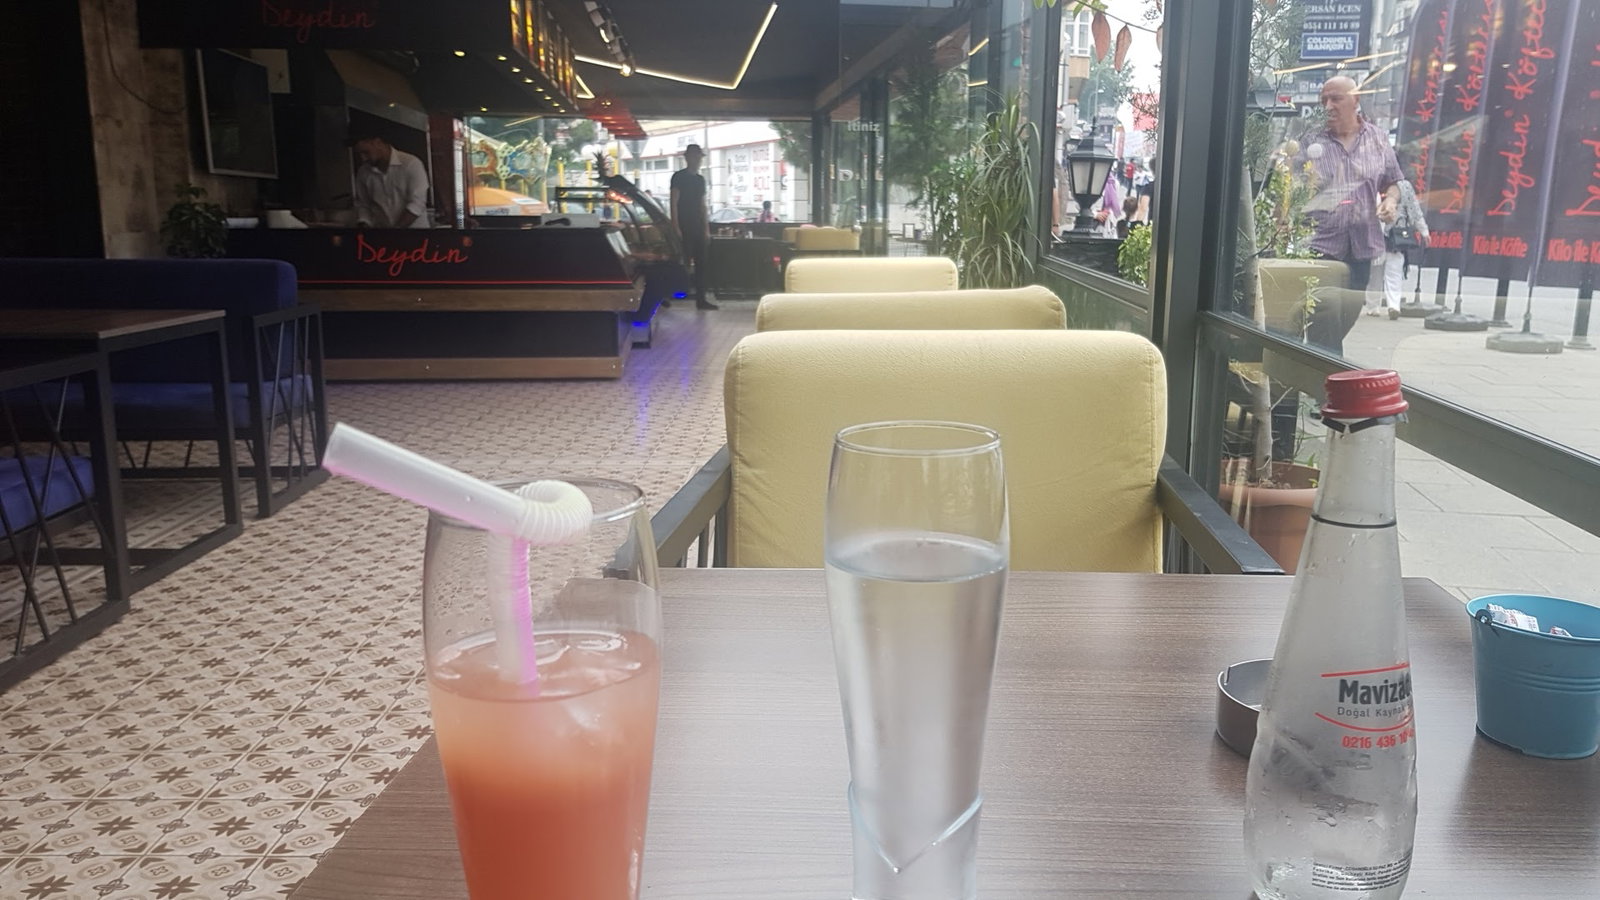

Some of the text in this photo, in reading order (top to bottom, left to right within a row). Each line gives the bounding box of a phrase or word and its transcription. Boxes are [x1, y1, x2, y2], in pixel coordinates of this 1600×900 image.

[1486, 114, 1535, 216] Deydin
[356, 231, 468, 277] Deydin
[1337, 706, 1370, 718] Doğal
[1342, 735, 1372, 749] 0216
